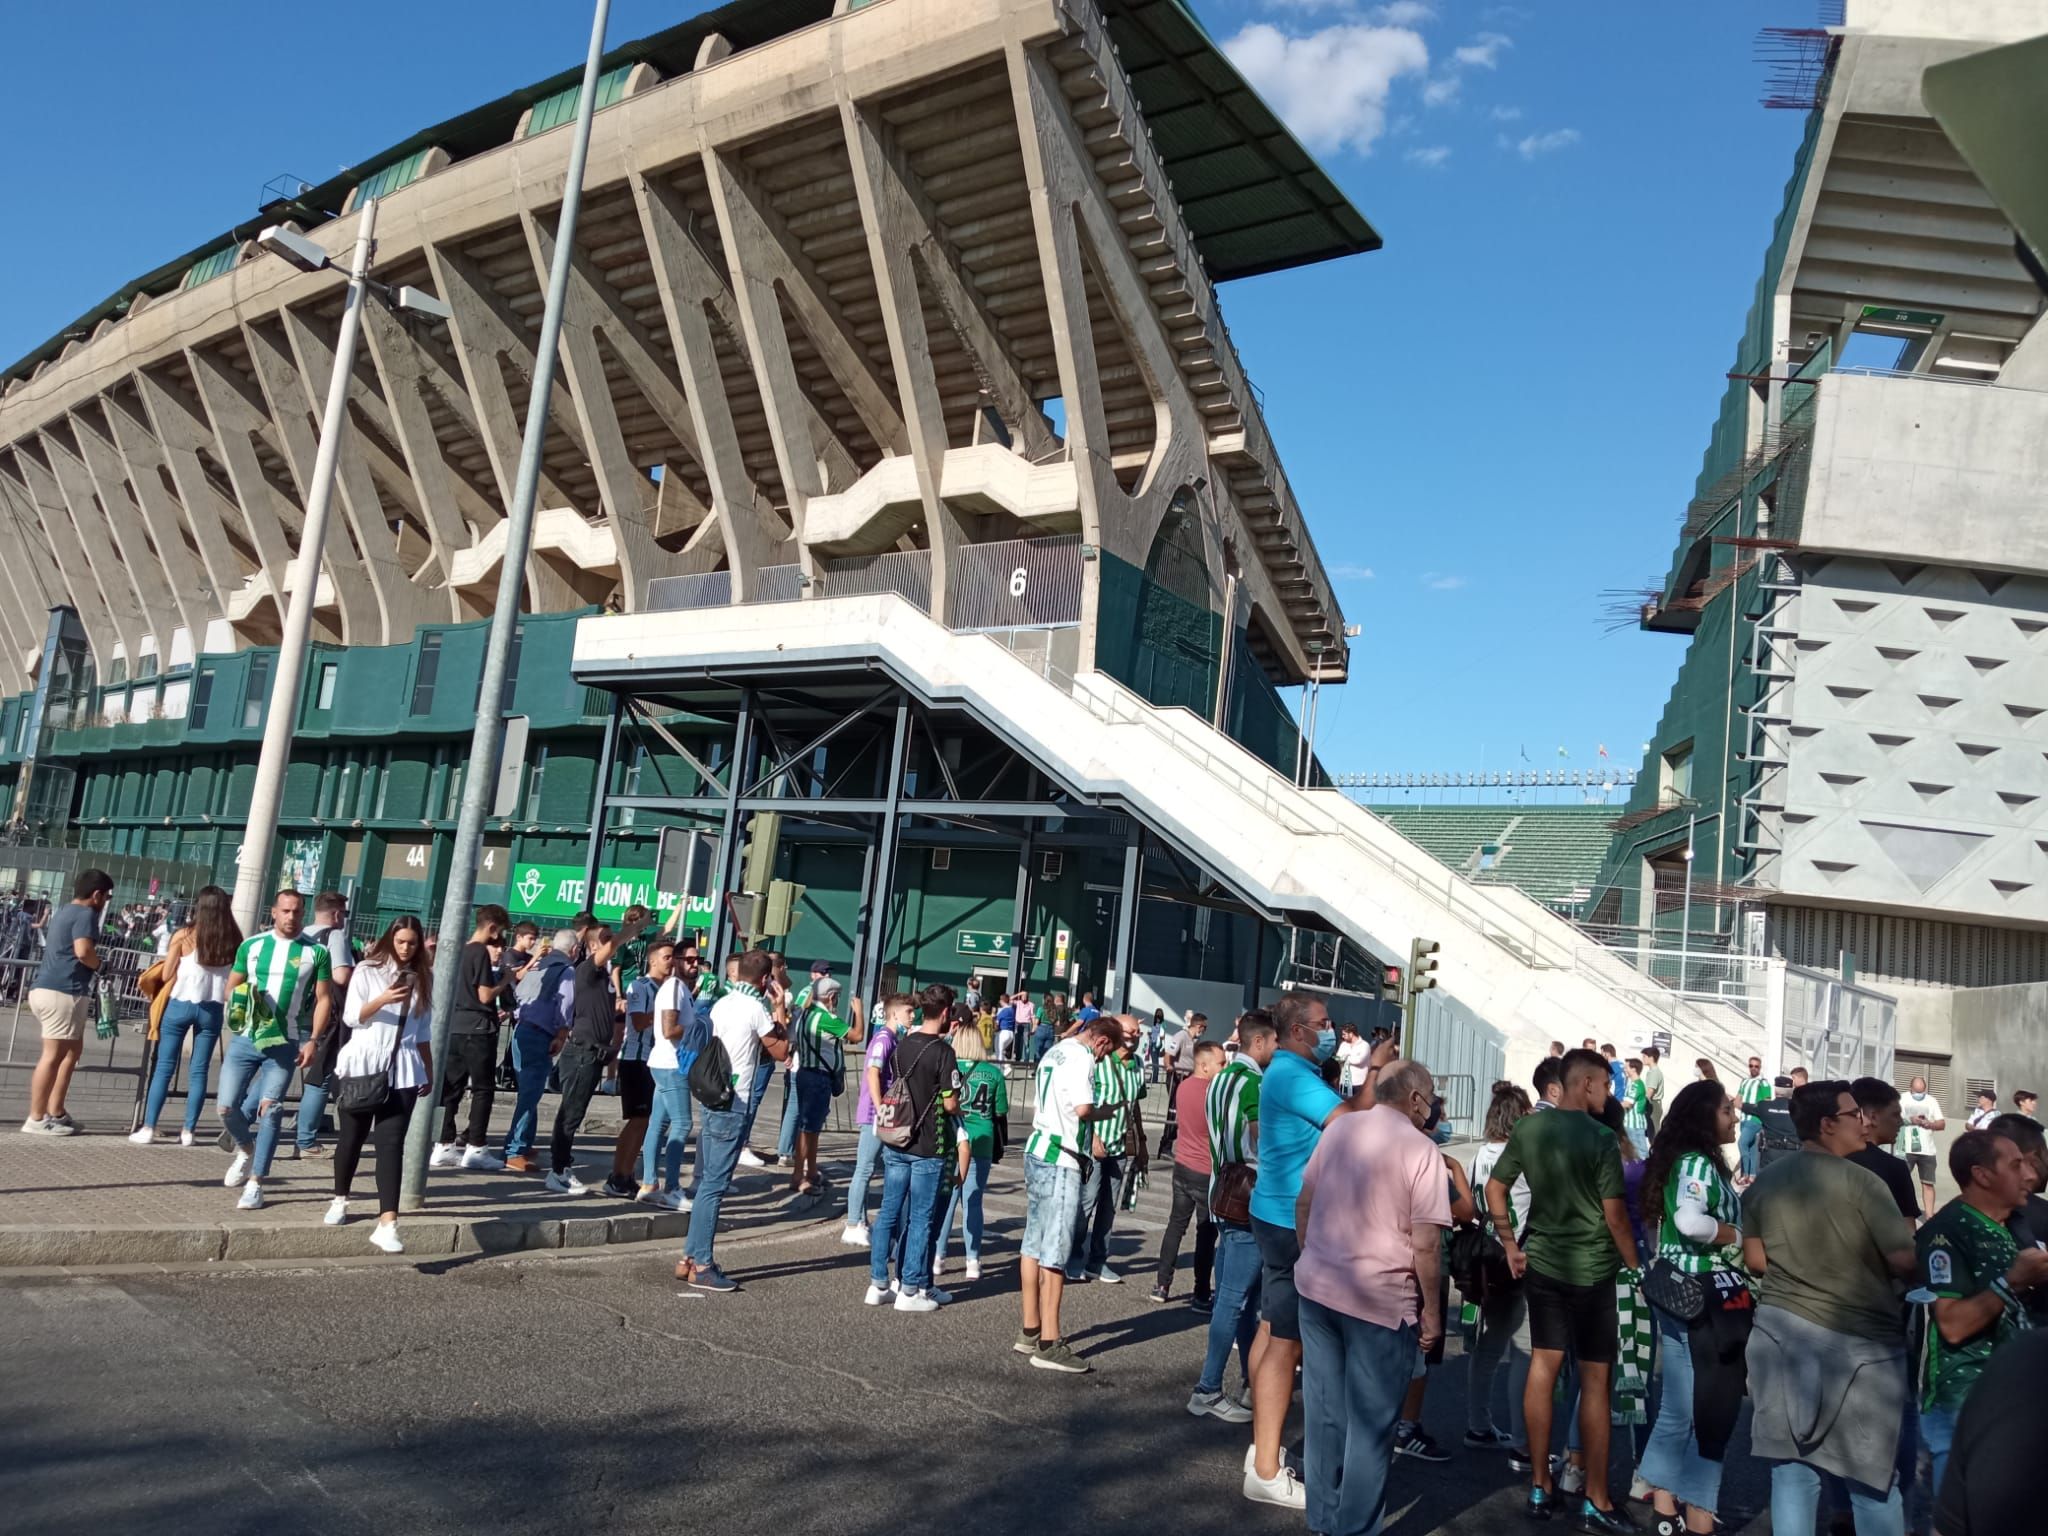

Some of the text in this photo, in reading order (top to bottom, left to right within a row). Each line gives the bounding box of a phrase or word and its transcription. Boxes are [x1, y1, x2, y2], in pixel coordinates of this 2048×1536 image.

[1009, 567, 1027, 597] 6
[406, 845, 425, 867] 4A
[483, 849, 495, 871] 4
[556, 875, 632, 907] ATECIÓN
[634, 884, 653, 909] AL
